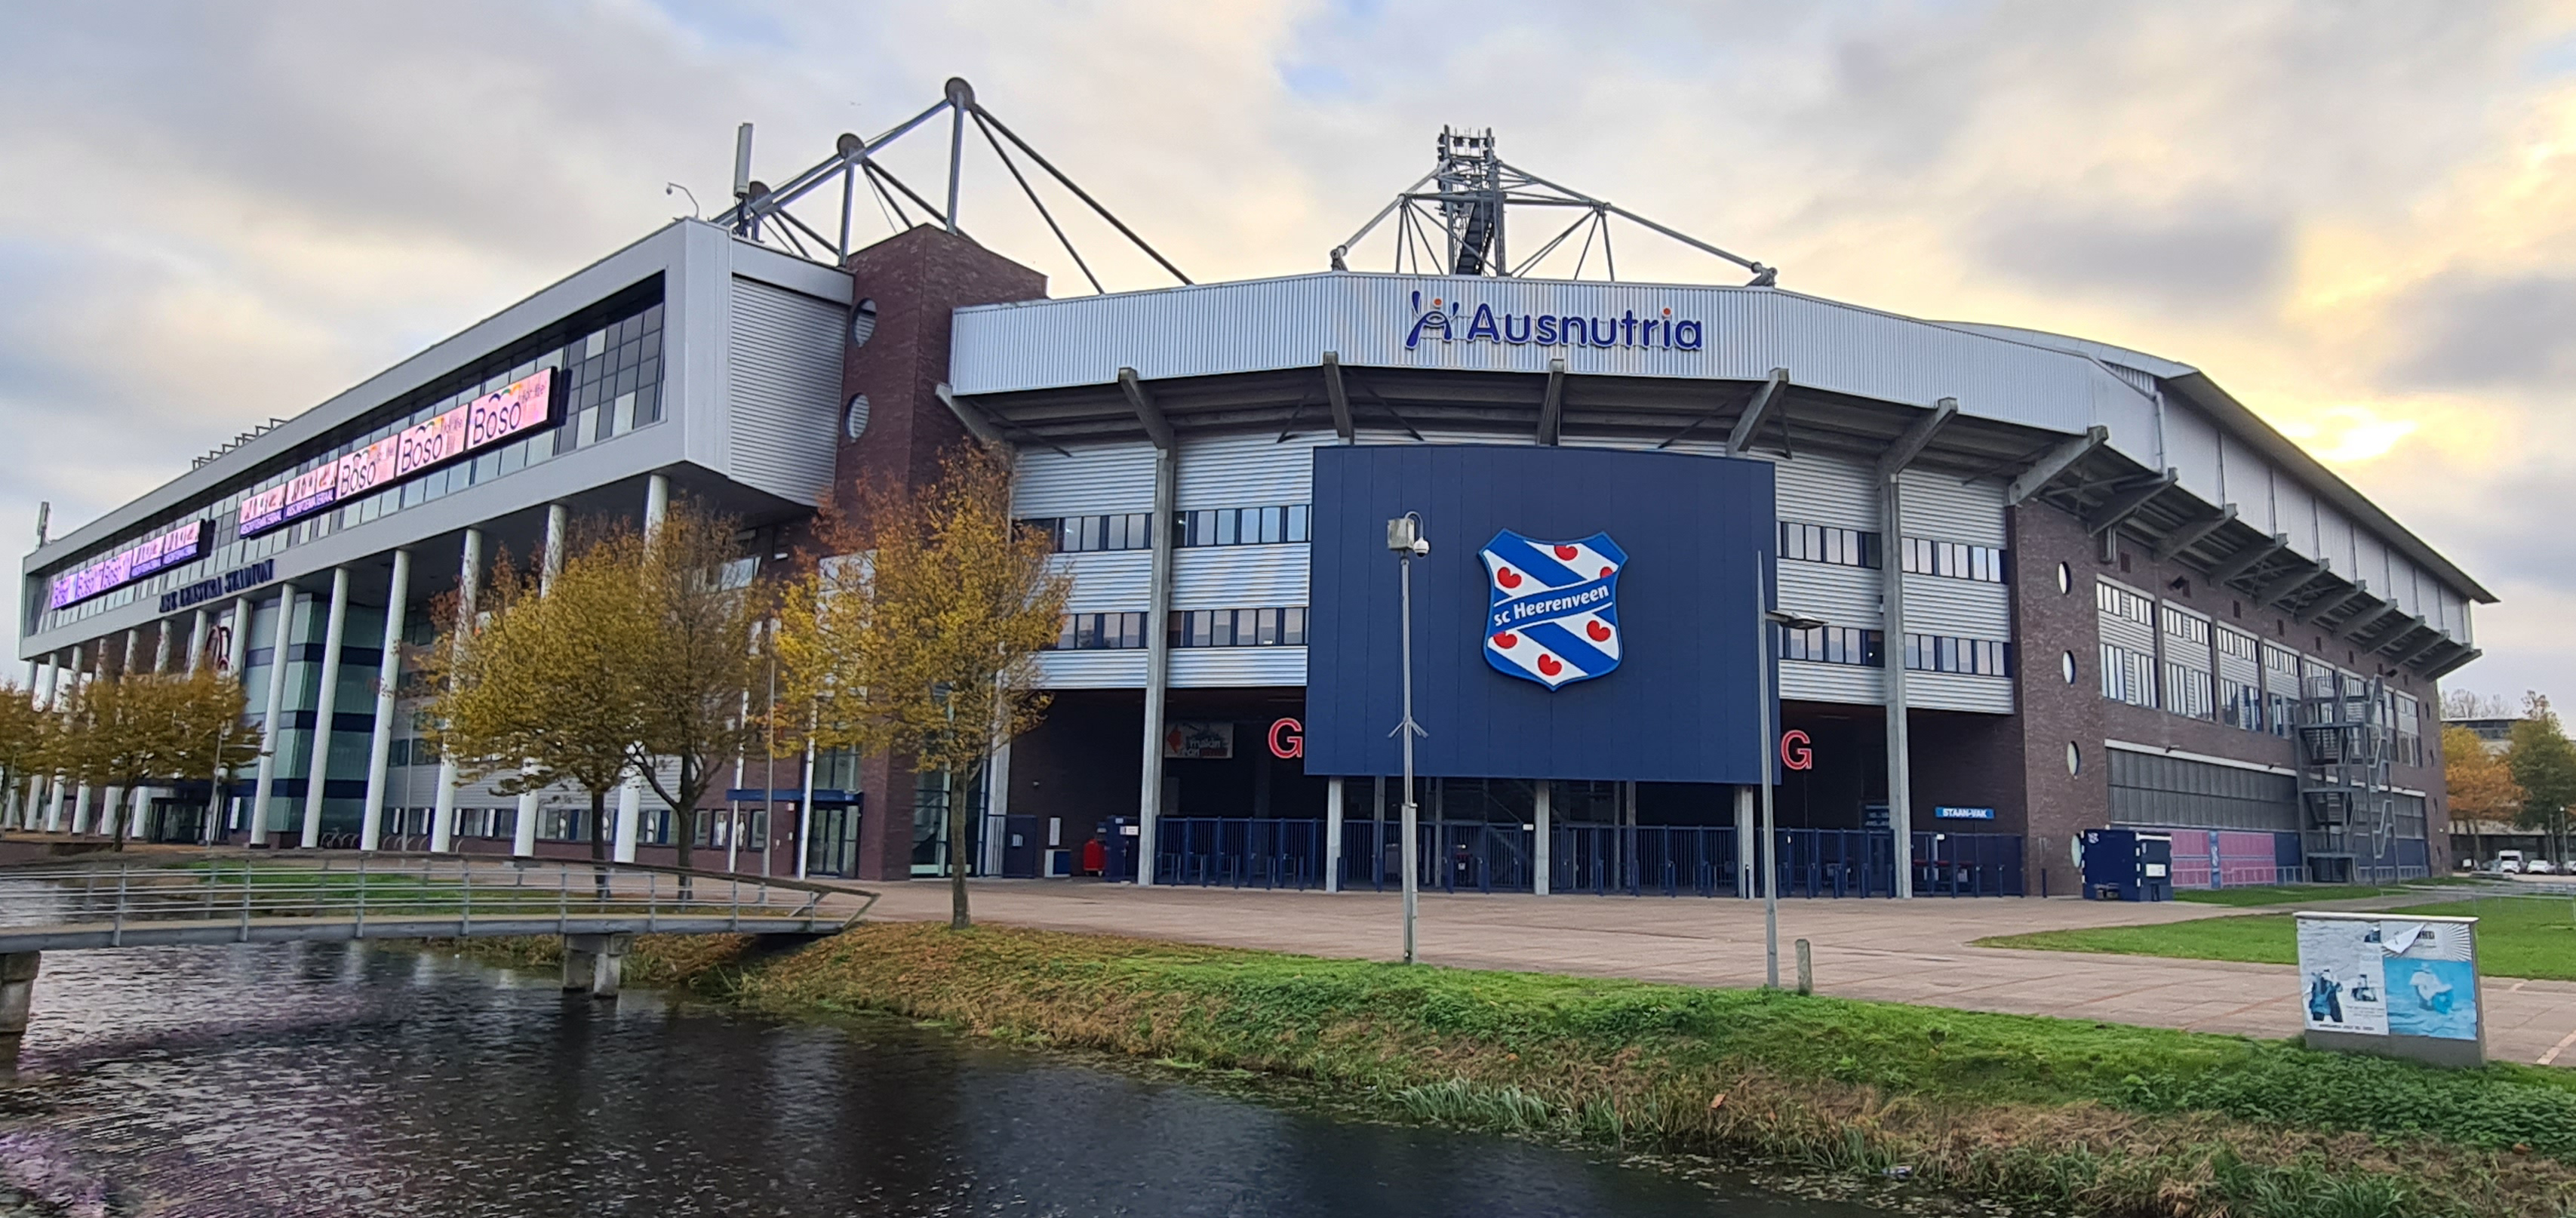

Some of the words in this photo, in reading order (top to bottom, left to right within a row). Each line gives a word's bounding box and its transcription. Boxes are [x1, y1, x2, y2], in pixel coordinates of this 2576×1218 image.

[1467, 303, 1703, 350] Ausnutria
[473, 401, 521, 444] Boso
[402, 434, 443, 473] Boso
[1494, 610, 1511, 627] sc
[1514, 585, 1609, 620] Heerenveen
[1268, 717, 1303, 759] G
[1781, 729, 1812, 770] G
